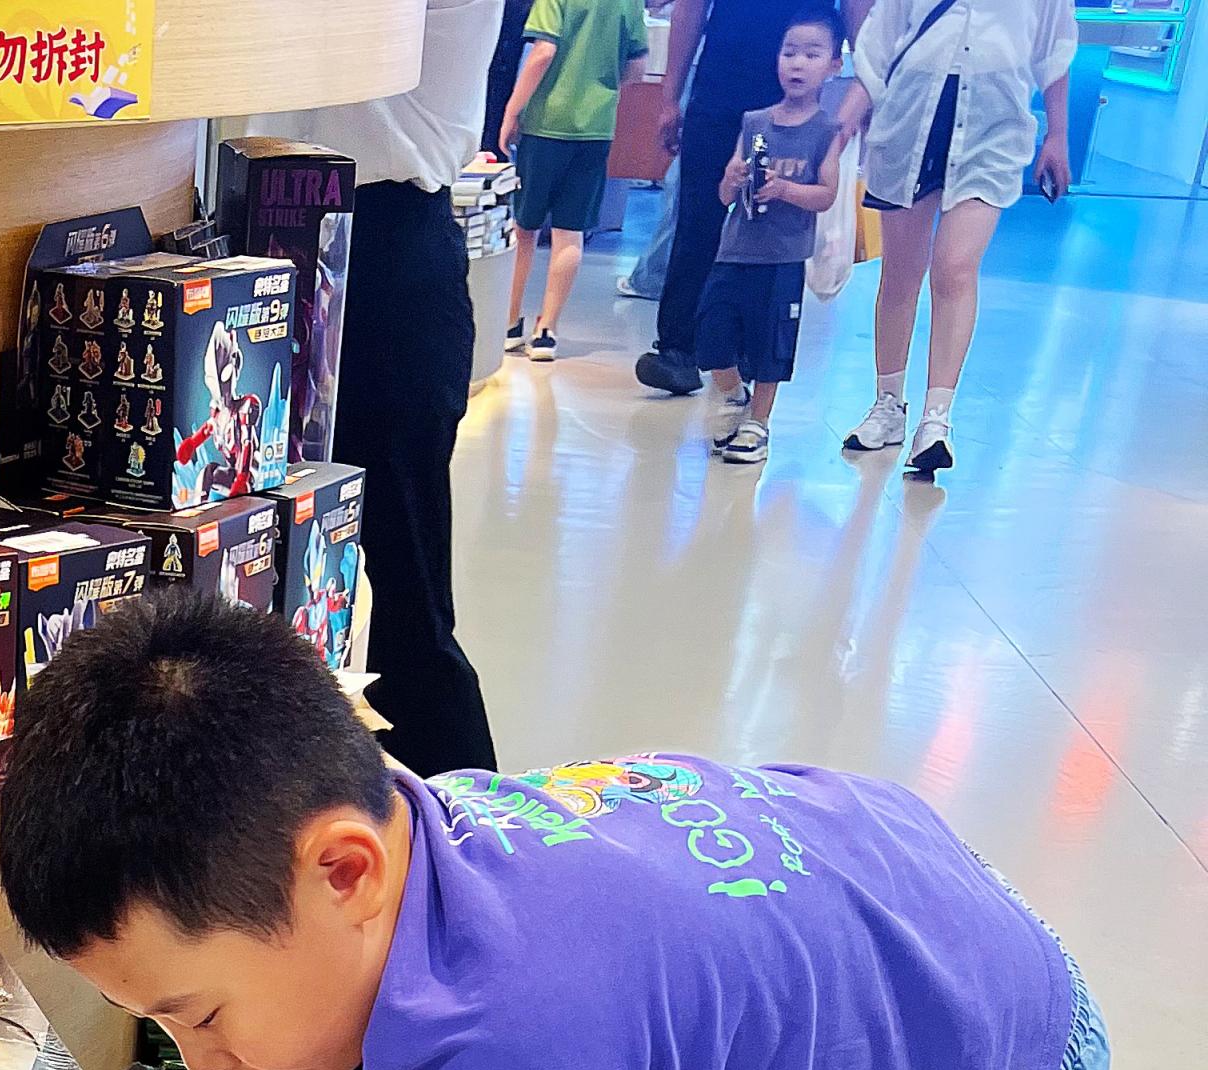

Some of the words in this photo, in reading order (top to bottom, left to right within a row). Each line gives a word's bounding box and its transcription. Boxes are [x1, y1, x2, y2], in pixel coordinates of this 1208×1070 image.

[260, 168, 342, 208] ULTRA
[259, 207, 307, 228] STRIKE
[226, 301, 290, 330] 闪耀版第9弹
